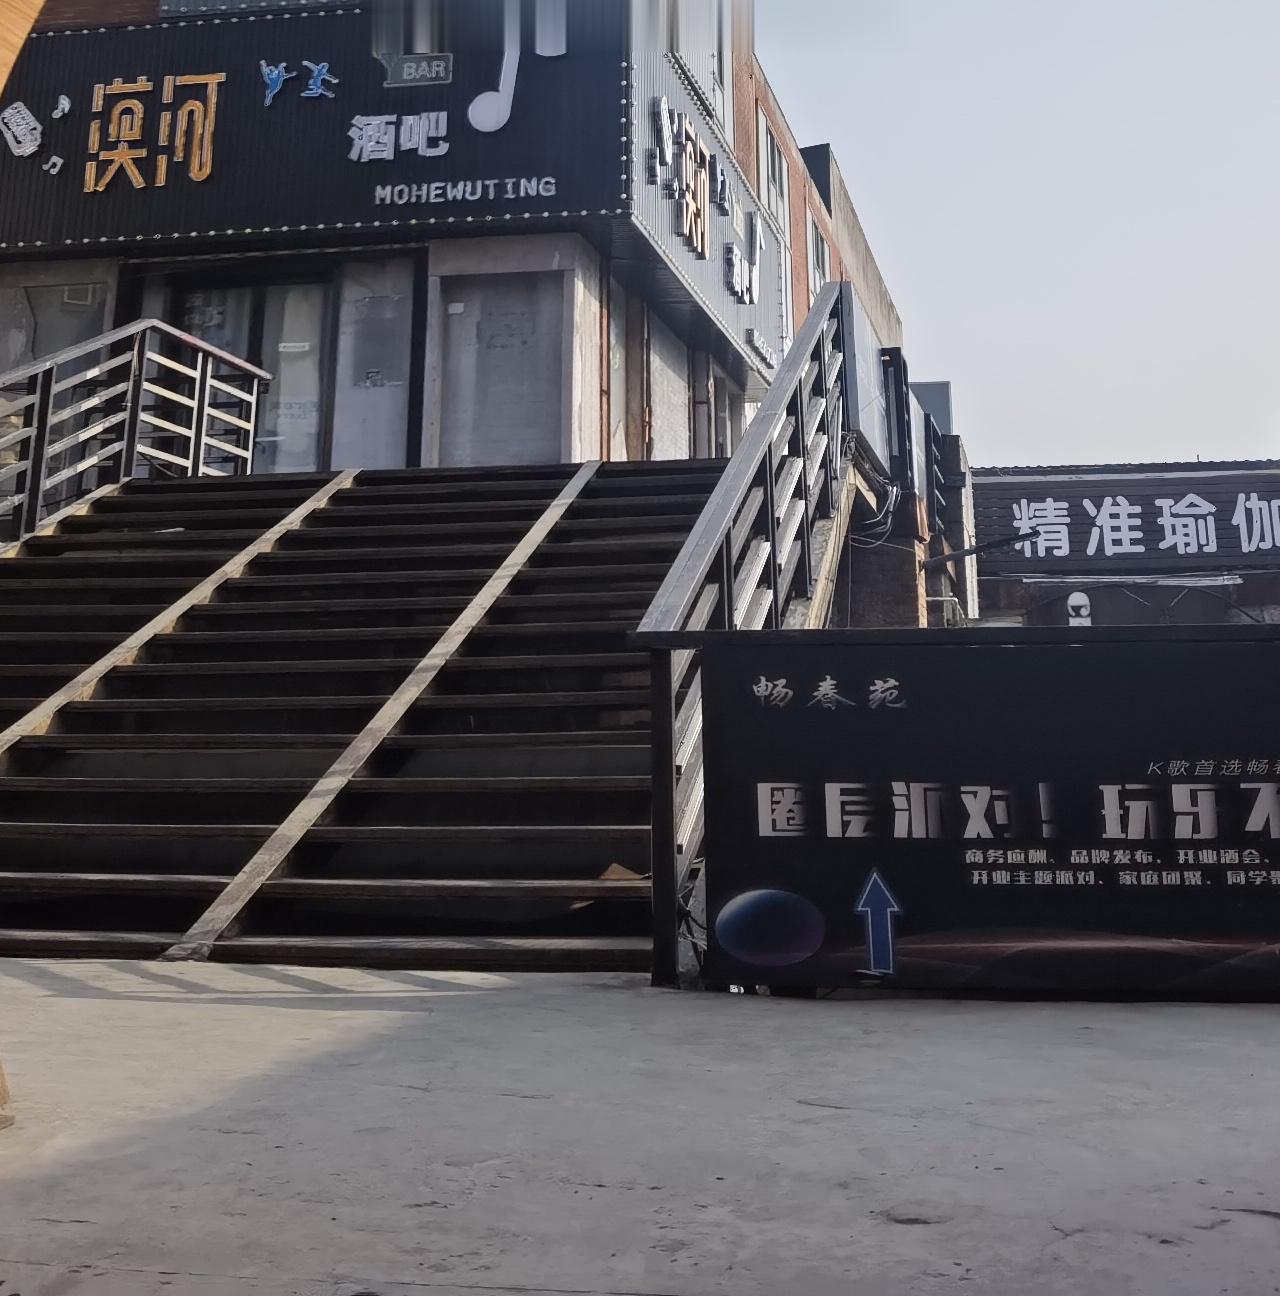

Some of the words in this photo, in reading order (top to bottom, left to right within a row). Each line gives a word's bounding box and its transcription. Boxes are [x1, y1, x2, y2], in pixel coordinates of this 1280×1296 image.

[403, 60, 446, 80] BAR
[83, 71, 227, 194] 漠河
[347, 111, 450, 164] 酒吧
[374, 176, 557, 206] MOHEWUTING
[751, 674, 907, 711] 畅春苑
